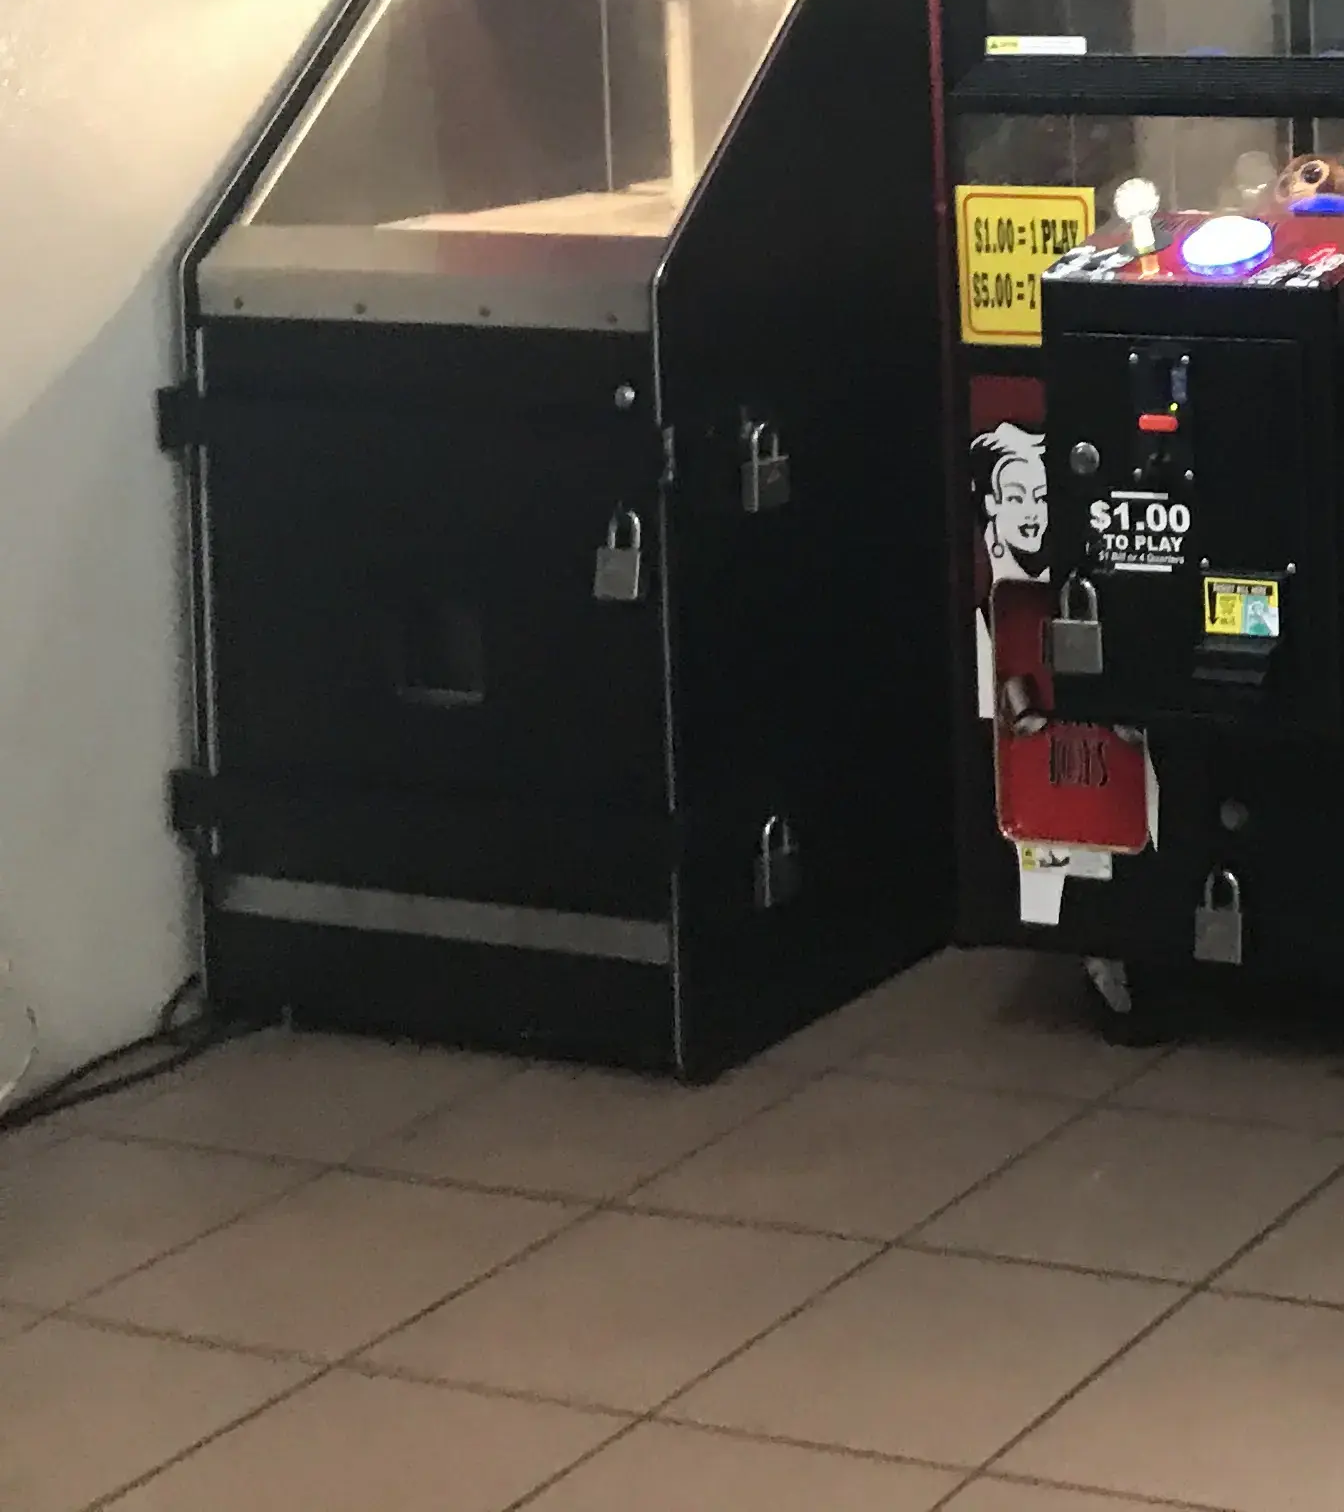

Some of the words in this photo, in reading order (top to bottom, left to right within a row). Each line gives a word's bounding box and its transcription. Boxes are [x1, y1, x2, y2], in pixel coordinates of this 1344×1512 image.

[974, 217, 1015, 255] $1.00
[1041, 219, 1079, 256] PLAY
[973, 271, 1013, 309] $5.00
[1089, 499, 1191, 534] $1.00
[1103, 533, 1129, 551] TO
[1135, 534, 1184, 553] PLAY
